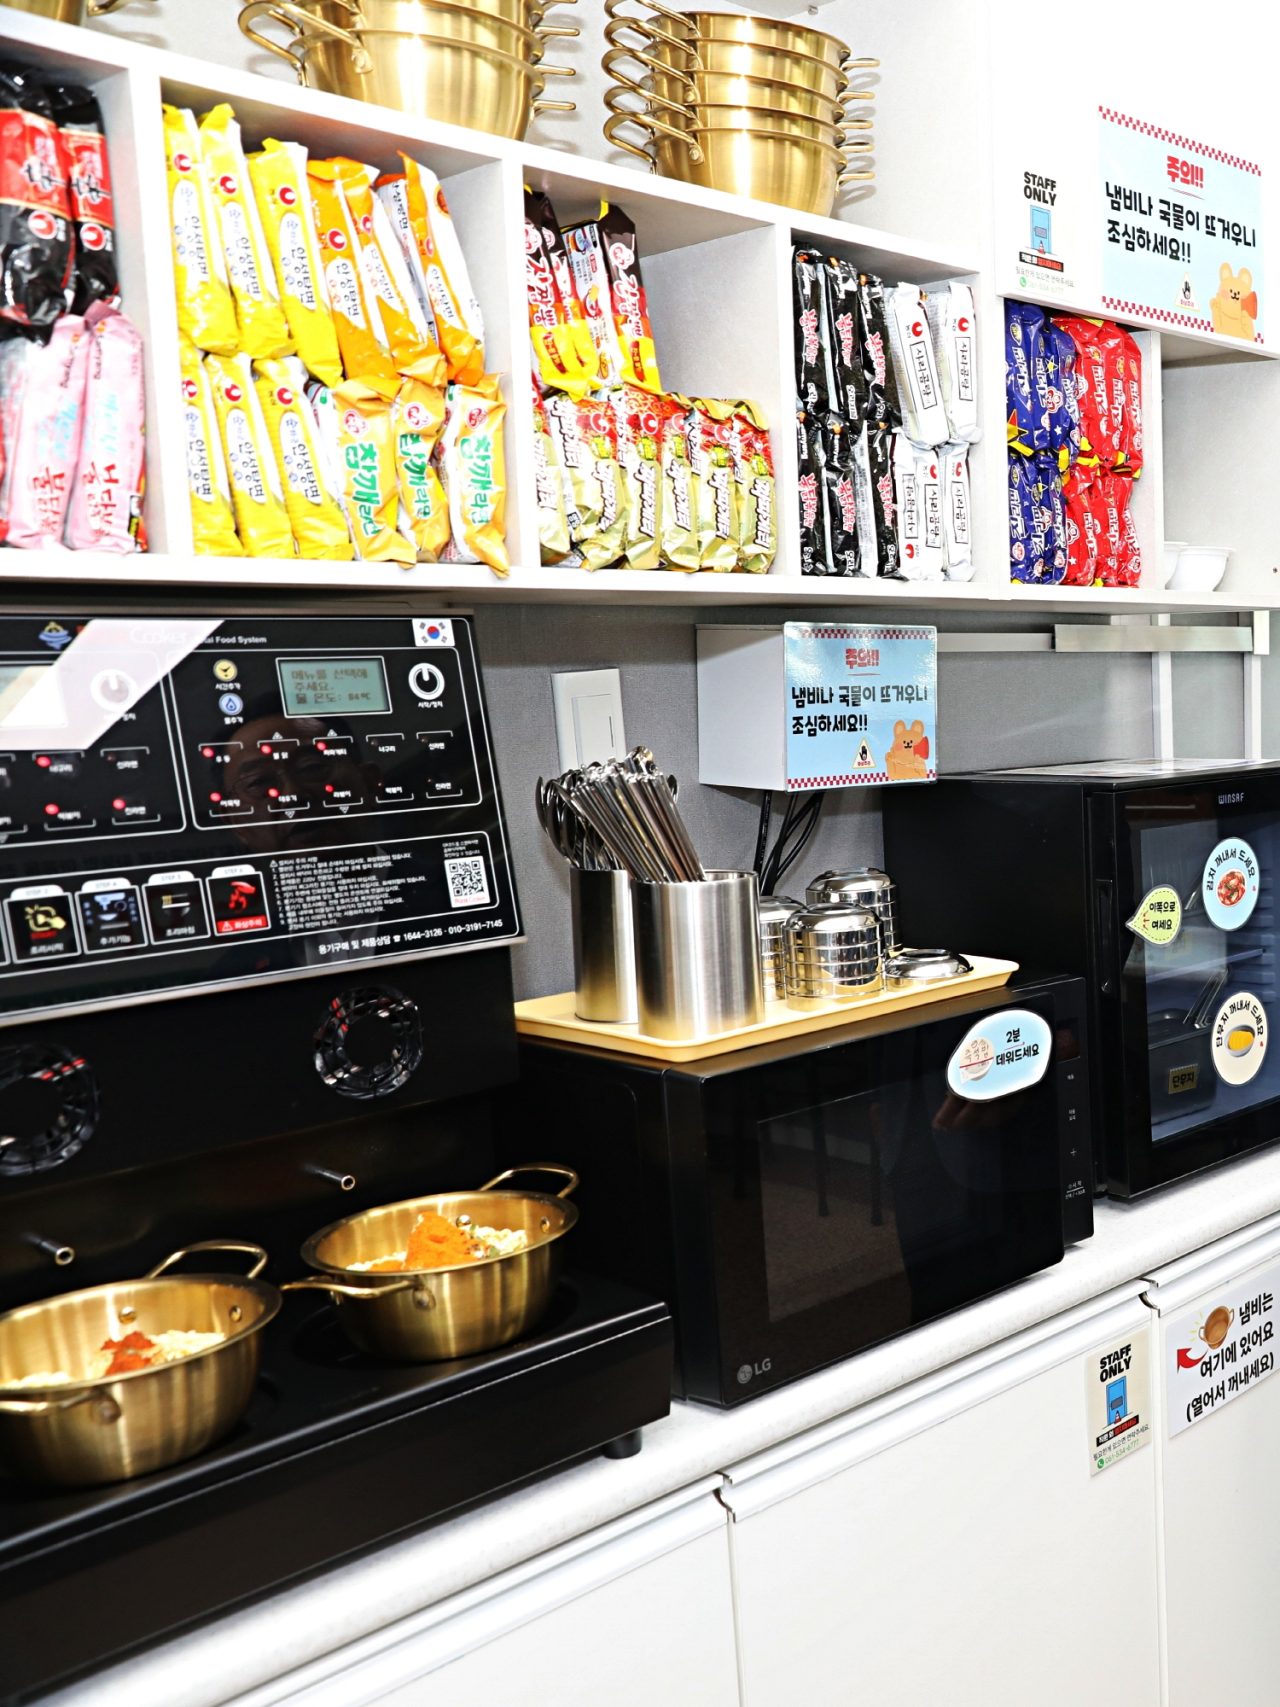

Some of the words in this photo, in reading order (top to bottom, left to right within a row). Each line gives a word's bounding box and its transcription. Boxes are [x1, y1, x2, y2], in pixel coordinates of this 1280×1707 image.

[1024, 171, 1056, 192] STAFF
[1024, 185, 1056, 206] ONLY
[1167, 155, 1204, 189] 주의!!
[1105, 181, 1153, 217] 냄비나
[1159, 198, 1200, 231] 국물이
[1205, 215, 1256, 247] 뜨거우니
[236, 236, 262, 295] 안성탕면
[1107, 218, 1191, 264] 조심하세요!!
[291, 247, 316, 304] 안성탕면
[336, 262, 360, 317] 안성탕면
[800, 308, 819, 365] 불닭볶음면
[836, 312, 853, 368] 불닭볶음면
[1091, 365, 1108, 415] 진라면
[1111, 378, 1124, 427] 진라면
[551, 397, 579, 469] 짜파게티
[190, 439, 213, 496] 안성탕면
[238, 441, 265, 498] 안성탕면
[293, 443, 321, 499] 안성탕면
[460, 435, 493, 524] 참깨라면
[634, 463, 656, 539] 짜파게티
[666, 457, 691, 533] 짜파게티
[708, 468, 731, 540] 짜파게티
[750, 478, 771, 550] 짜파게티
[799, 473, 817, 528] 불닭볶음면
[837, 477, 856, 534] 불닭볶음면
[1009, 488, 1027, 540] 진라면
[1031, 505, 1046, 556] 진라면
[1107, 507, 1119, 555] 진라면
[238, 635, 267, 645] System
[845, 648, 880, 670] 주의!!
[292, 669, 326, 680] 메뉴를
[334, 668, 367, 679] 선택해
[791, 686, 834, 709] 냄비나
[838, 685, 876, 707] 국물이
[880, 684, 928, 704] 뜨거우니
[792, 714, 868, 737] 조심하세요!!
[1207, 867, 1217, 891] 김치
[1214, 848, 1237, 868] 꺼내서
[1238, 850, 1255, 878] 드세요
[318, 943, 350, 955] 용기구매
[351, 941, 359, 950] 및
[361, 936, 391, 947] 제품상담
[403, 929, 443, 941] 1644-3126
[448, 919, 503, 935] 010-3191-7145
[1151, 919, 1173, 930] 여세요
[1006, 1027, 1020, 1043] 2분
[1216, 1012, 1229, 1048] 단무지
[1229, 1000, 1250, 1014] 꺼내서
[1250, 1005, 1264, 1036] 드세요
[995, 1043, 1039, 1066] 데워드세요
[1172, 1072, 1194, 1088] 단무지
[1240, 1293, 1274, 1326] 냄비는
[754, 1358, 772, 1375] LG
[1100, 1344, 1132, 1370] STAFF
[1100, 1356, 1132, 1382] ONLY
[1200, 1342, 1237, 1378] 여기에
[1240, 1321, 1274, 1357] 있어요
[1186, 1381, 1225, 1422] (열어서
[1227, 1352, 1274, 1392] 꺼내세요)
